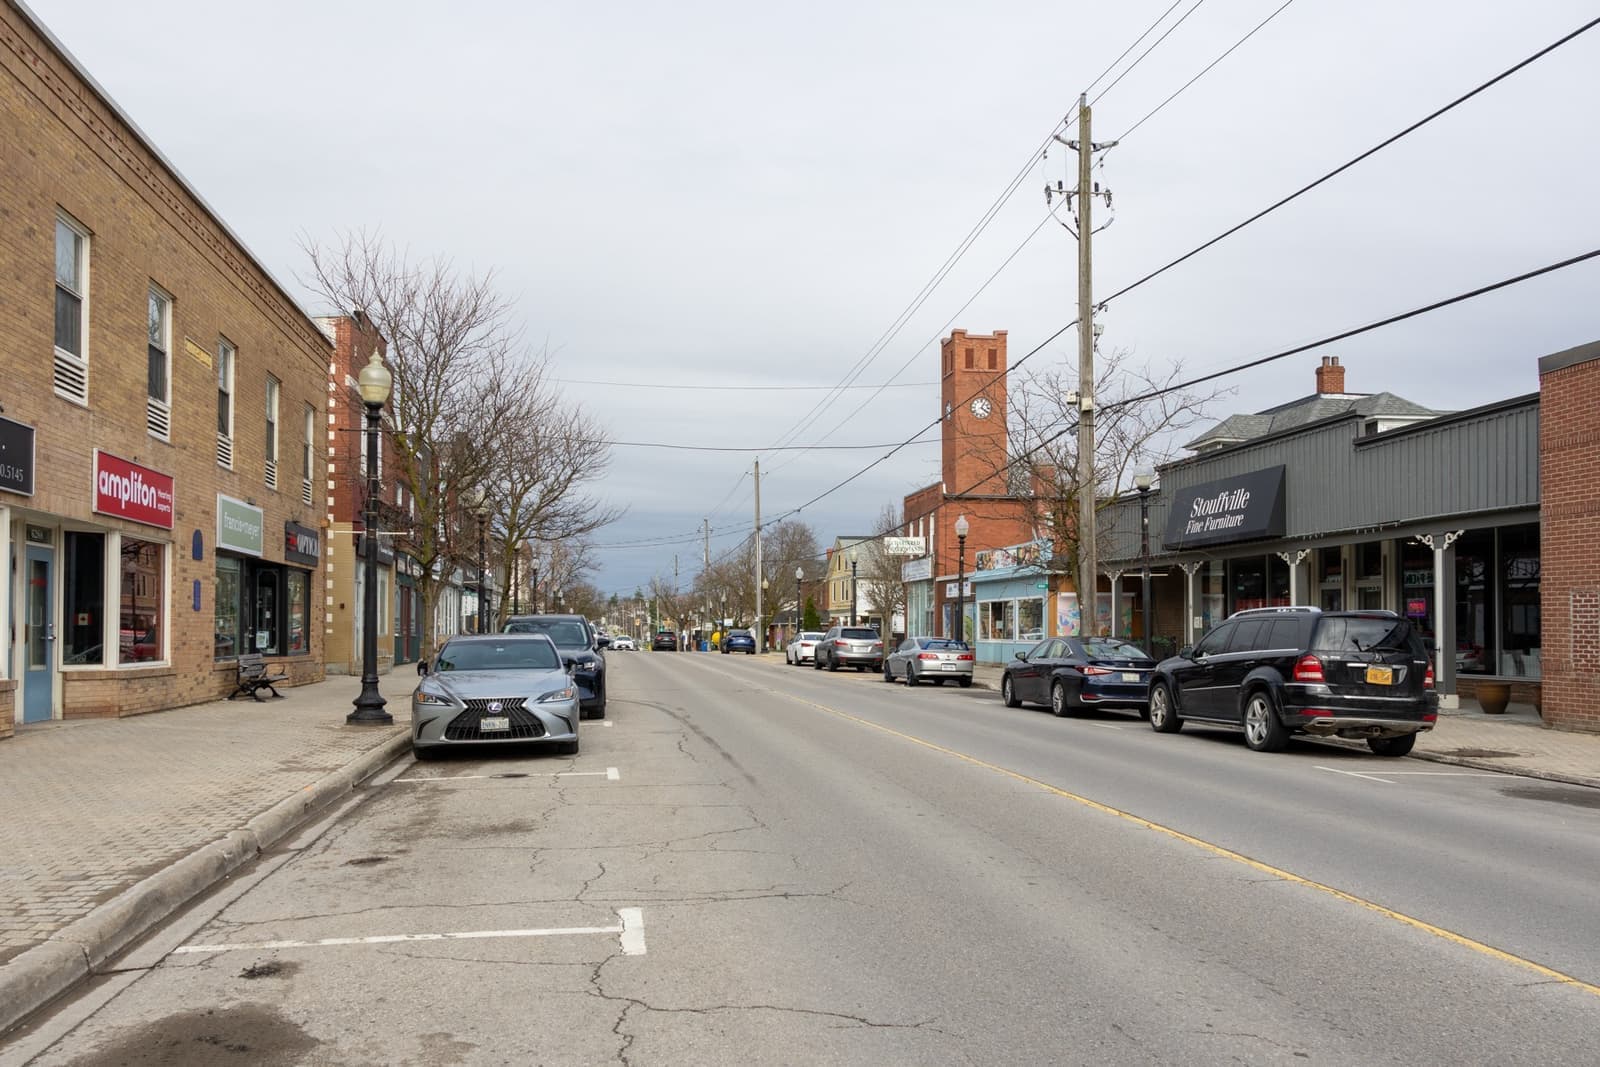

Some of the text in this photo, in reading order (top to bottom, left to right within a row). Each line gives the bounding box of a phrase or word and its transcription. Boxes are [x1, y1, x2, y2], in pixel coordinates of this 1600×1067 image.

[98, 470, 157, 510] amplifon
[1190, 488, 1250, 518] Stouffville
[1185, 514, 1244, 535] Fine Furniture
